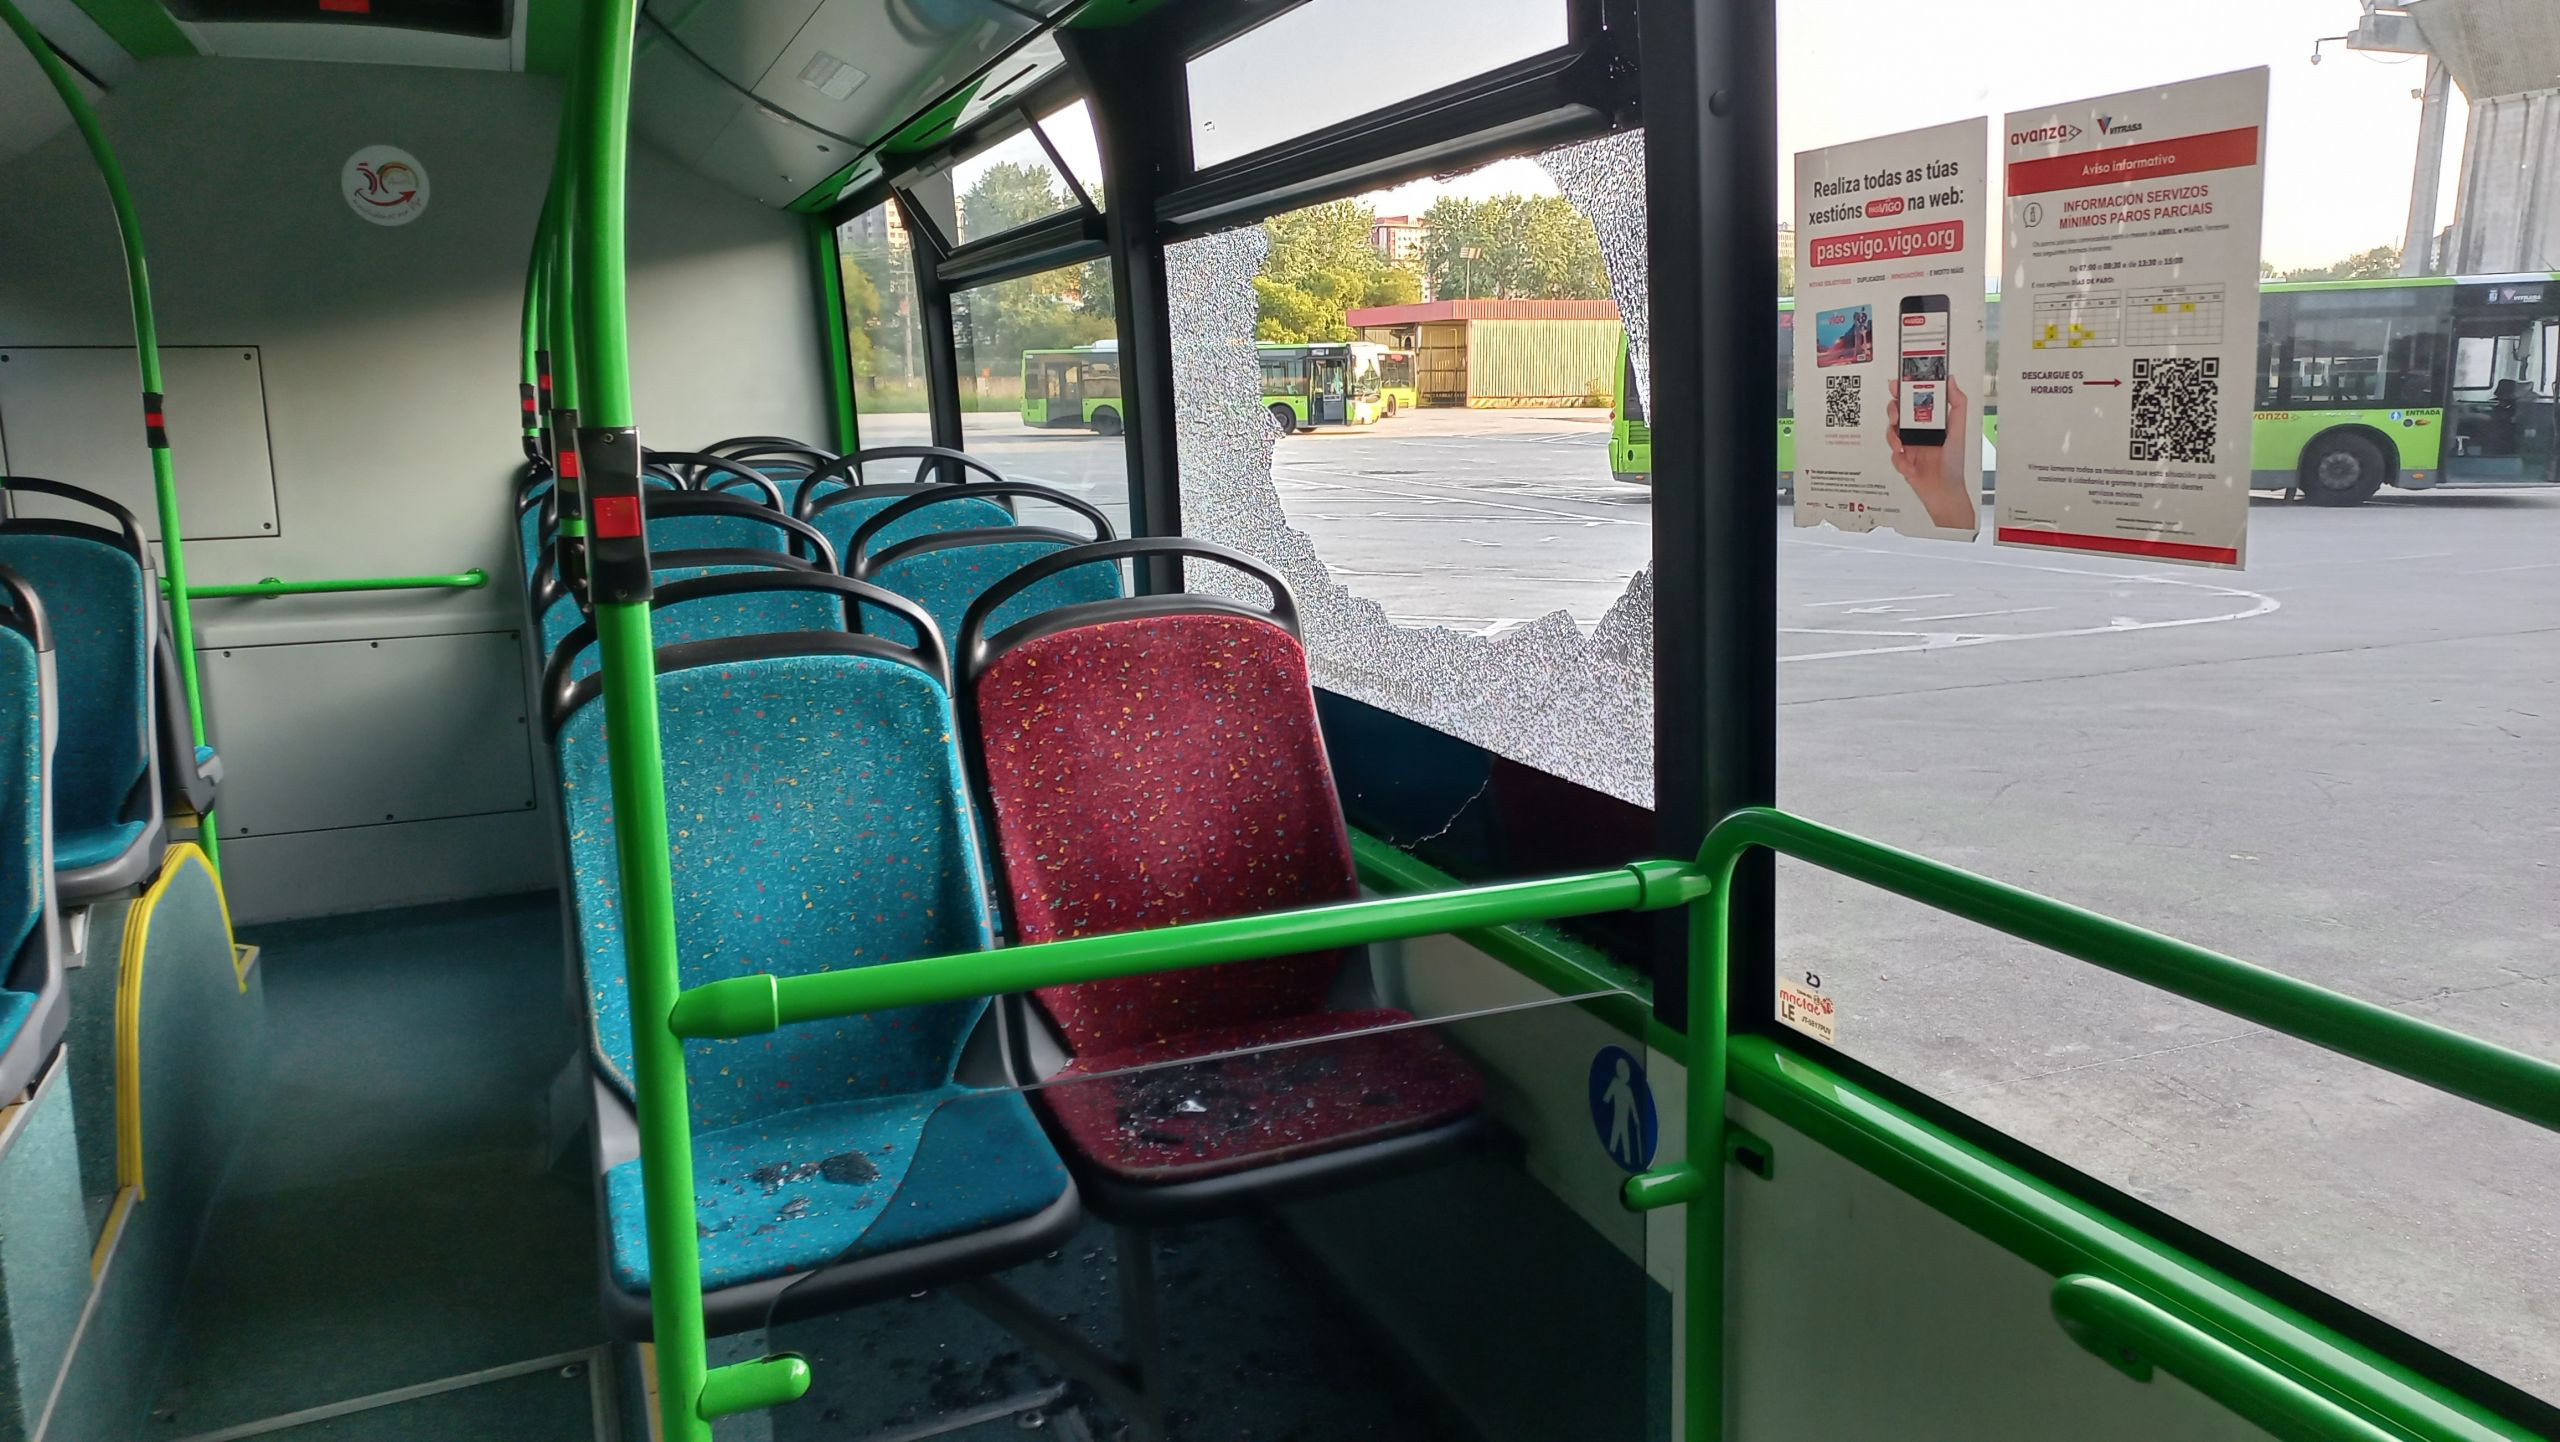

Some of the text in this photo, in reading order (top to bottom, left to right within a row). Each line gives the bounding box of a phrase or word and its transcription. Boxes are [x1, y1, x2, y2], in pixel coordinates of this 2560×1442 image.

[2010, 125, 2067, 145] avanza
[2082, 154, 2176, 175] Aviso informativo
[1814, 160, 1958, 198] Realiza todas as túas
[2147, 185, 2209, 203] SERVIZOS
[1809, 203, 1862, 225] xestións
[1908, 196, 1924, 211] na
[1929, 187, 1964, 207] web:
[2110, 208, 2151, 223] PAROS
[2154, 202, 2213, 219] PARCIAIS
[1816, 228, 1955, 264] passvigo.vigo.org
[2021, 370, 2084, 380] DESCARGUE OS
[2030, 385, 2074, 394] HORARIOS
